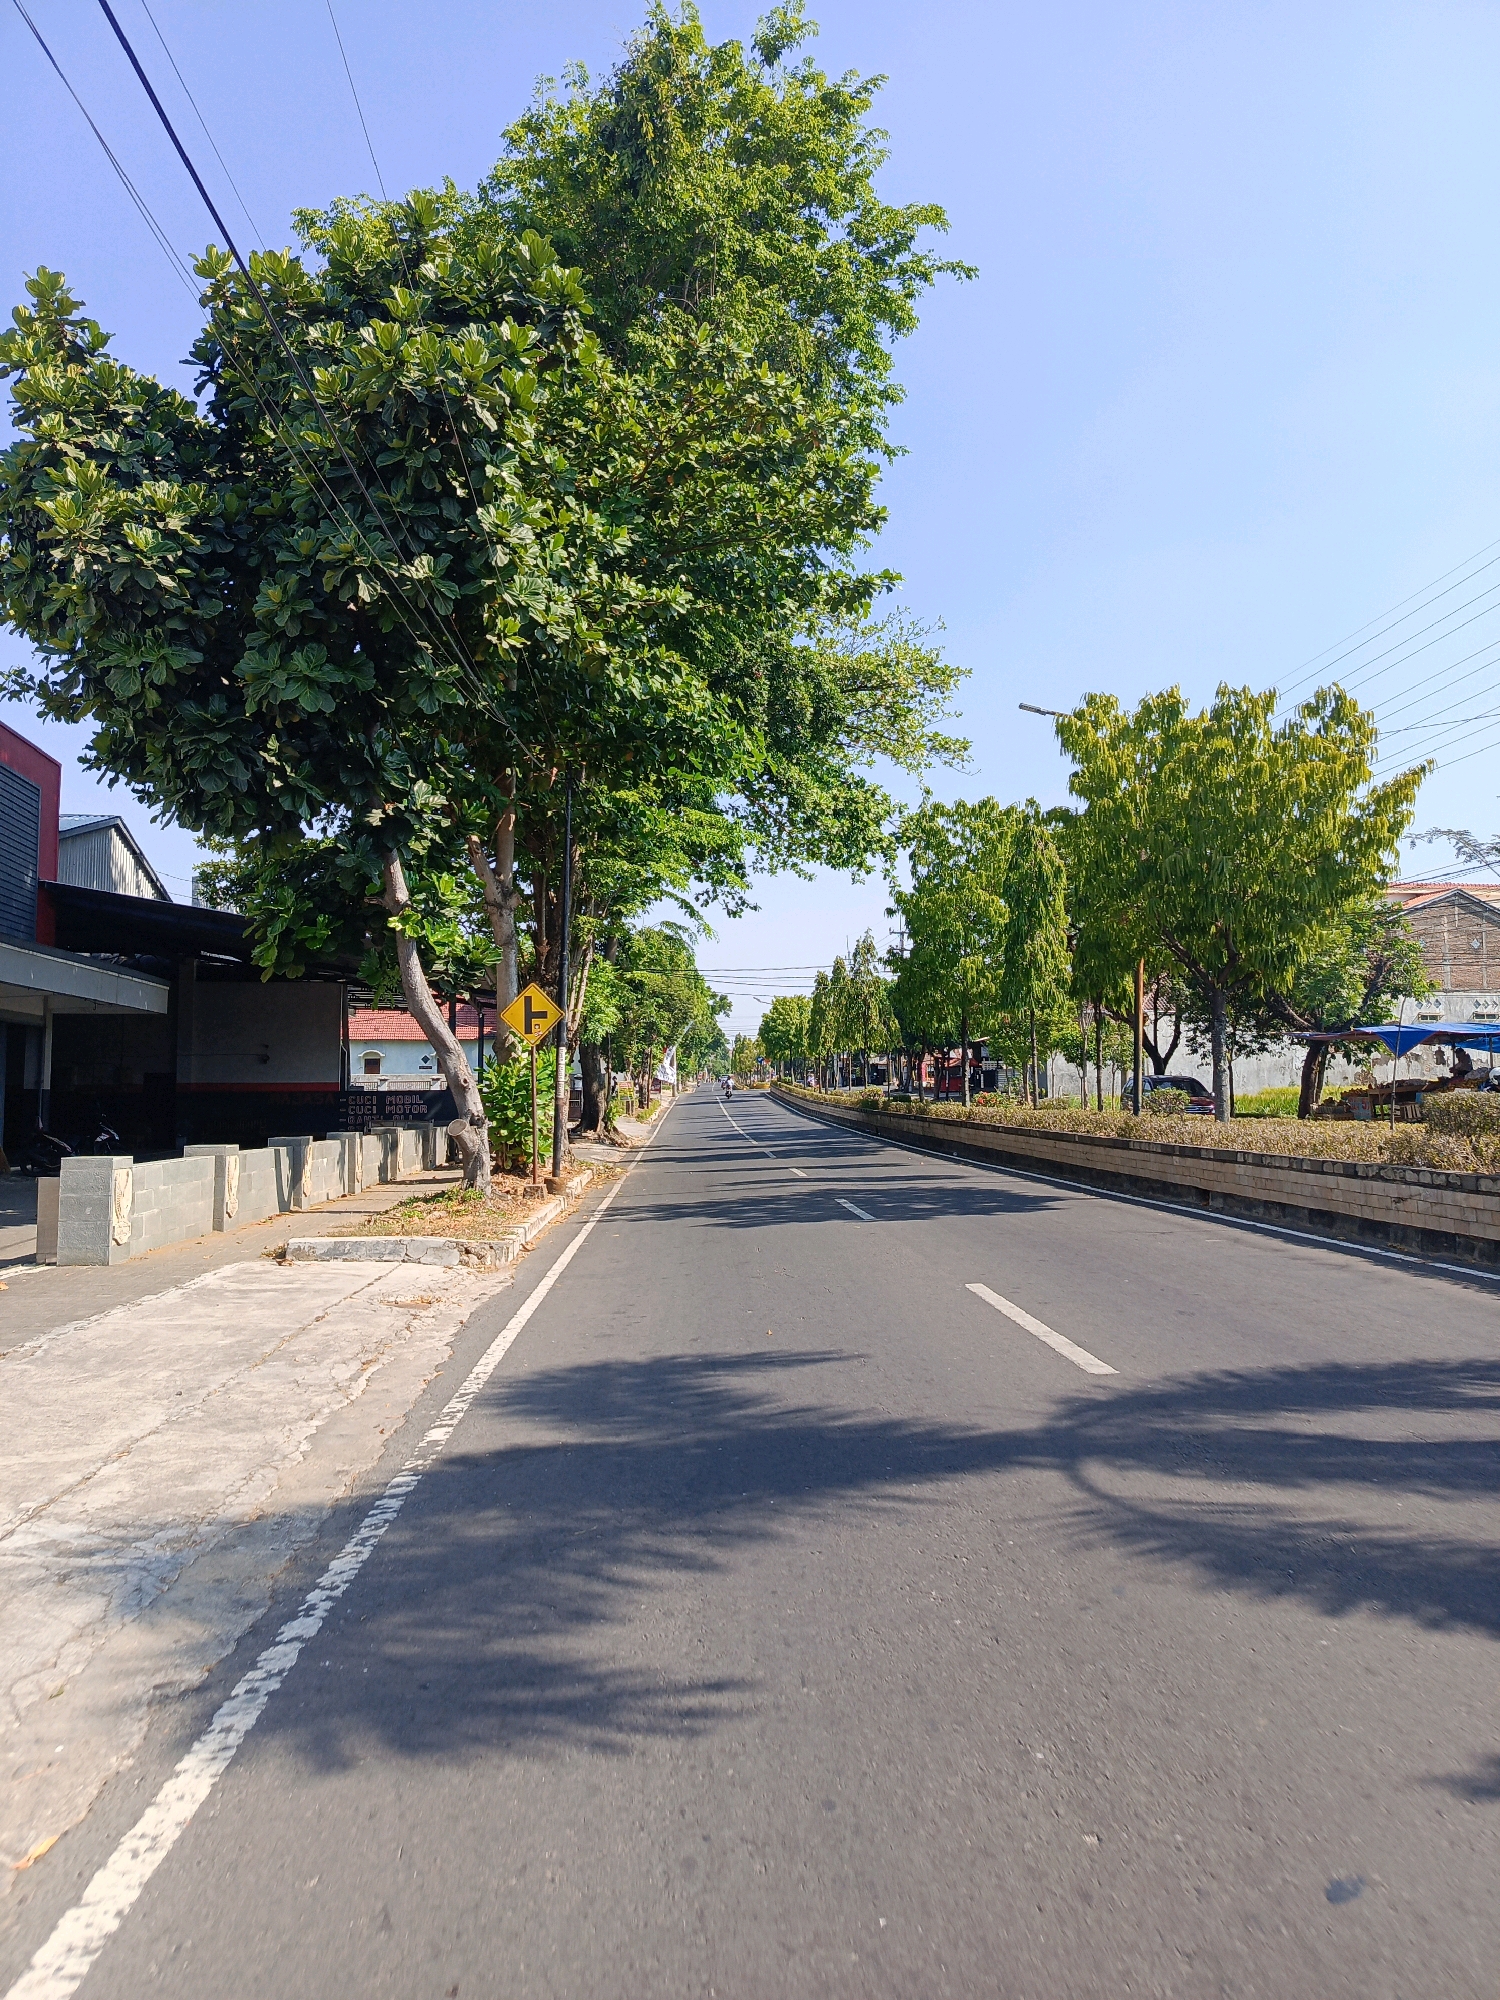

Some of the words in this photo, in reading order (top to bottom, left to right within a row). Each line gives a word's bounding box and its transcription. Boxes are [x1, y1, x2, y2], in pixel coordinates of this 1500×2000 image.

[348, 1095, 377, 1105] CUCI
[385, 1094, 424, 1104] MOBIL
[348, 1105, 377, 1115] CUCI
[385, 1104, 428, 1114] MOTOR
